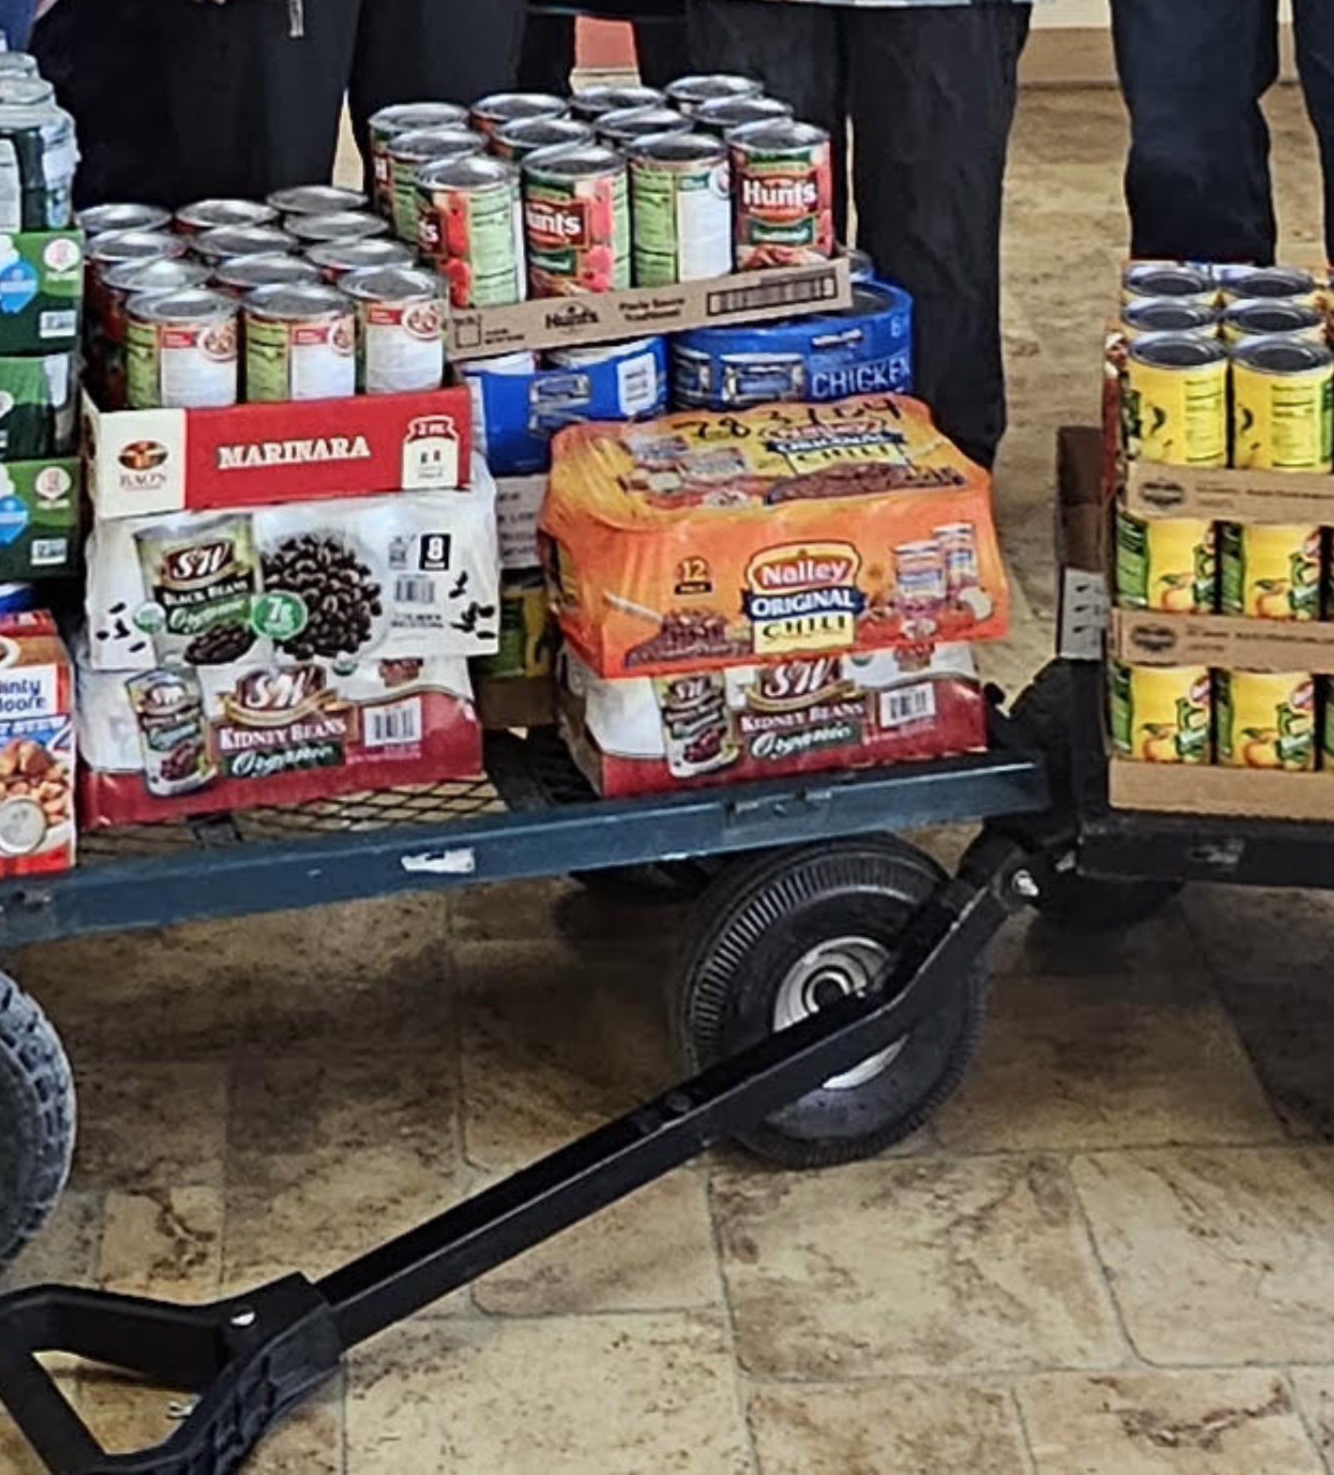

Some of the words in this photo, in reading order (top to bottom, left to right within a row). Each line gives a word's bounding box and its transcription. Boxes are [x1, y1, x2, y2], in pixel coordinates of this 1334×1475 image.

[743, 179, 817, 207] Hunt's
[525, 208, 580, 237] unt's
[217, 436, 371, 469] MARINARA
[428, 536, 444, 560] 8
[682, 559, 705, 582] 12
[761, 558, 848, 587] Nalley
[750, 589, 857, 616] ORIGINAL
[762, 615, 846, 641] CHILI
[740, 712, 808, 733] KIDNEY
[809, 702, 864, 723] BEANS
[220, 728, 288, 750] KIDNEY
[290, 717, 346, 742] BEANS
